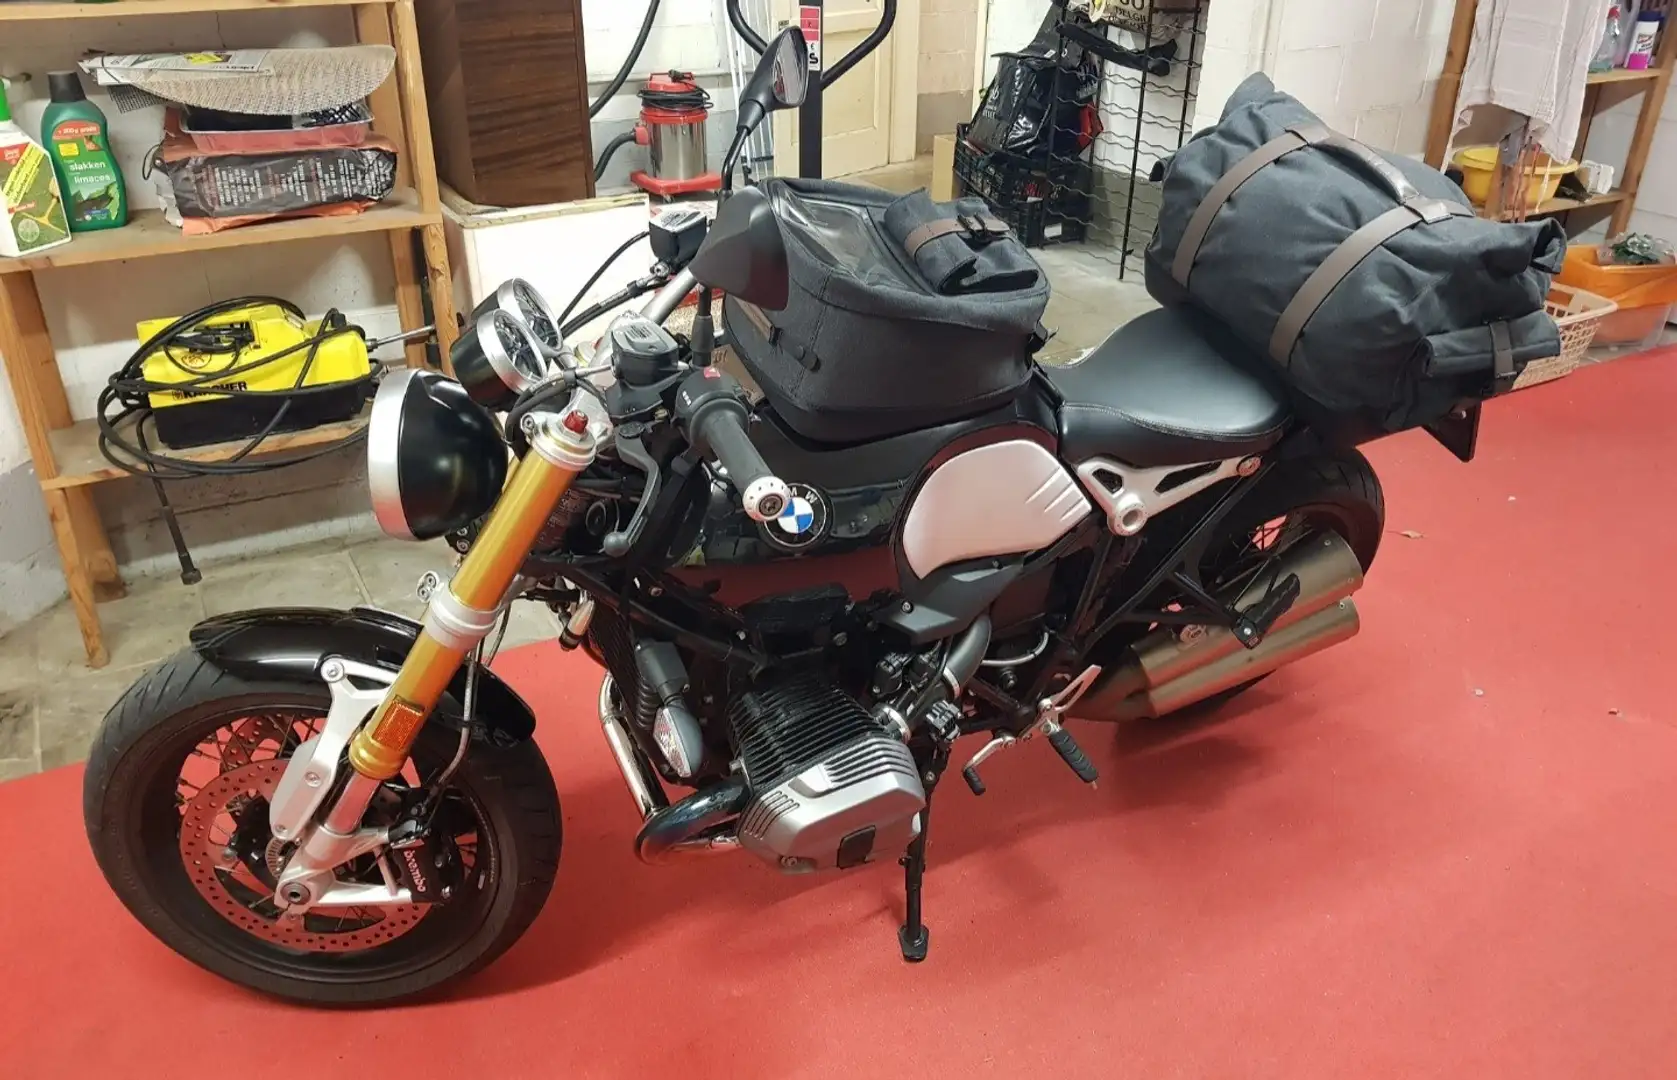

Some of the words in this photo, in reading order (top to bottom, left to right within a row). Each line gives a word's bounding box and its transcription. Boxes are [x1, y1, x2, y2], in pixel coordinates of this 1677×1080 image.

[69, 161, 106, 171] slakken
[74, 174, 111, 184] limaces
[403, 850, 426, 892] brembo
